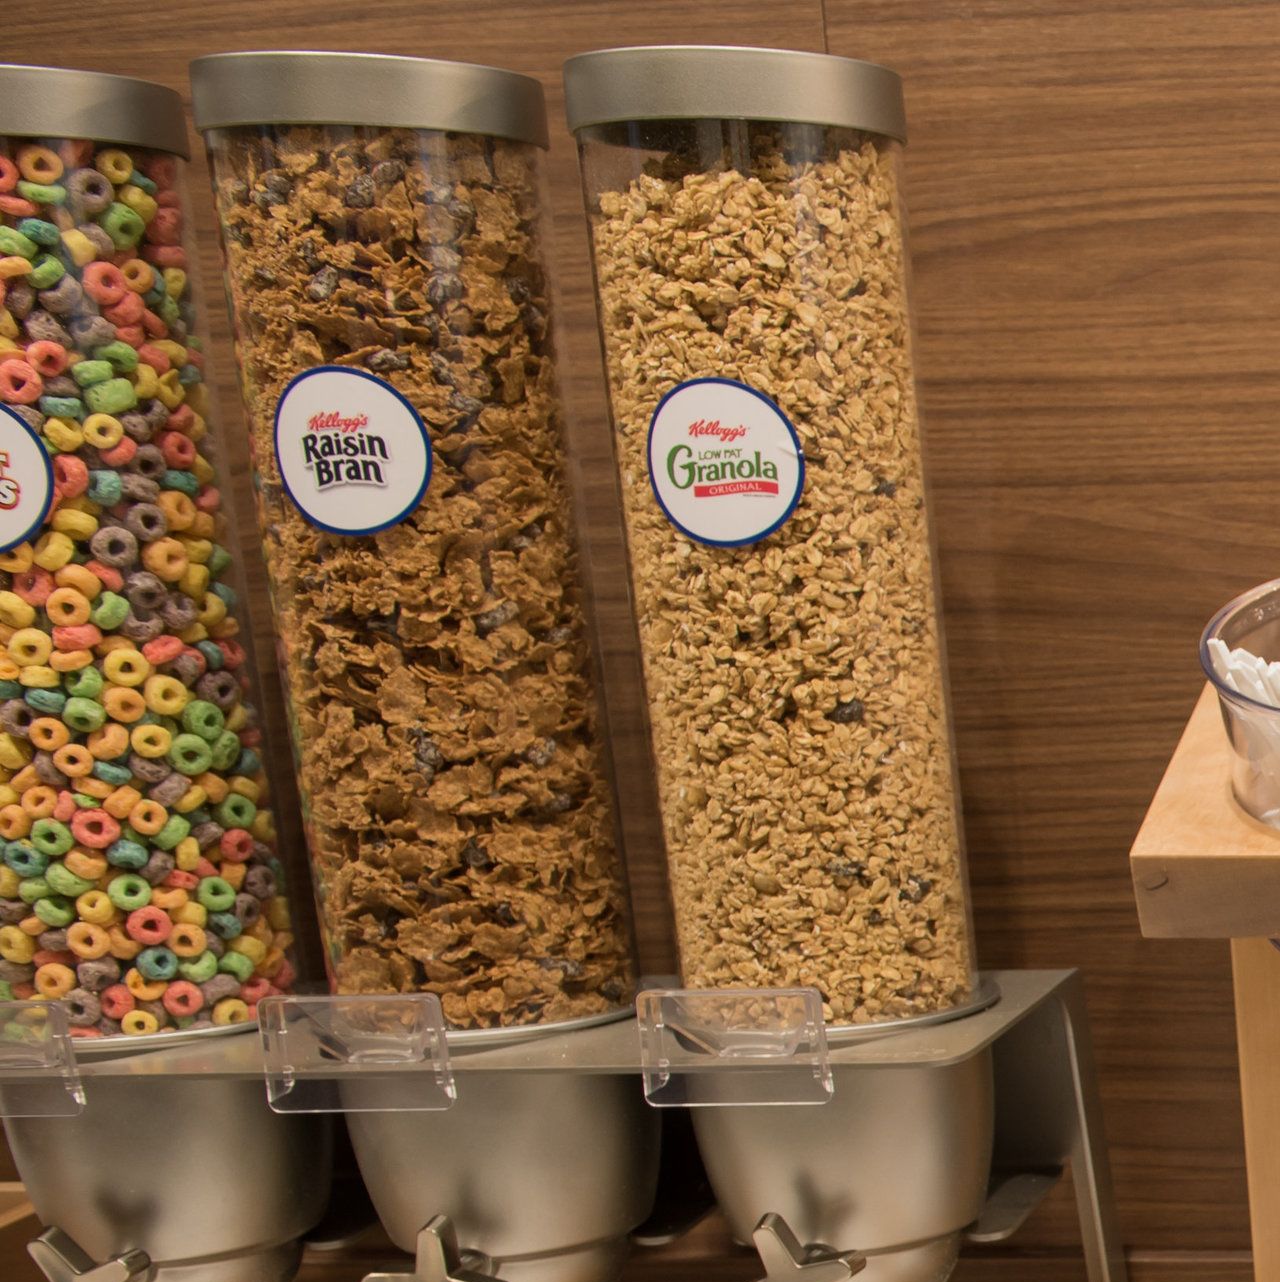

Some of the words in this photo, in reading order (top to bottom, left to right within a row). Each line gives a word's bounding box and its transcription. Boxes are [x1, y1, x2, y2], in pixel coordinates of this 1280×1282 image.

[308, 411, 369, 432] Kellogg's
[688, 420, 747, 441] Kellogg's
[301, 432, 389, 464] Raisin
[698, 450, 721, 460] LOW
[724, 448, 743, 459] FAT
[315, 458, 385, 488] Bran
[666, 444, 779, 490] Granola
[708, 483, 762, 495] ORIGINAL
